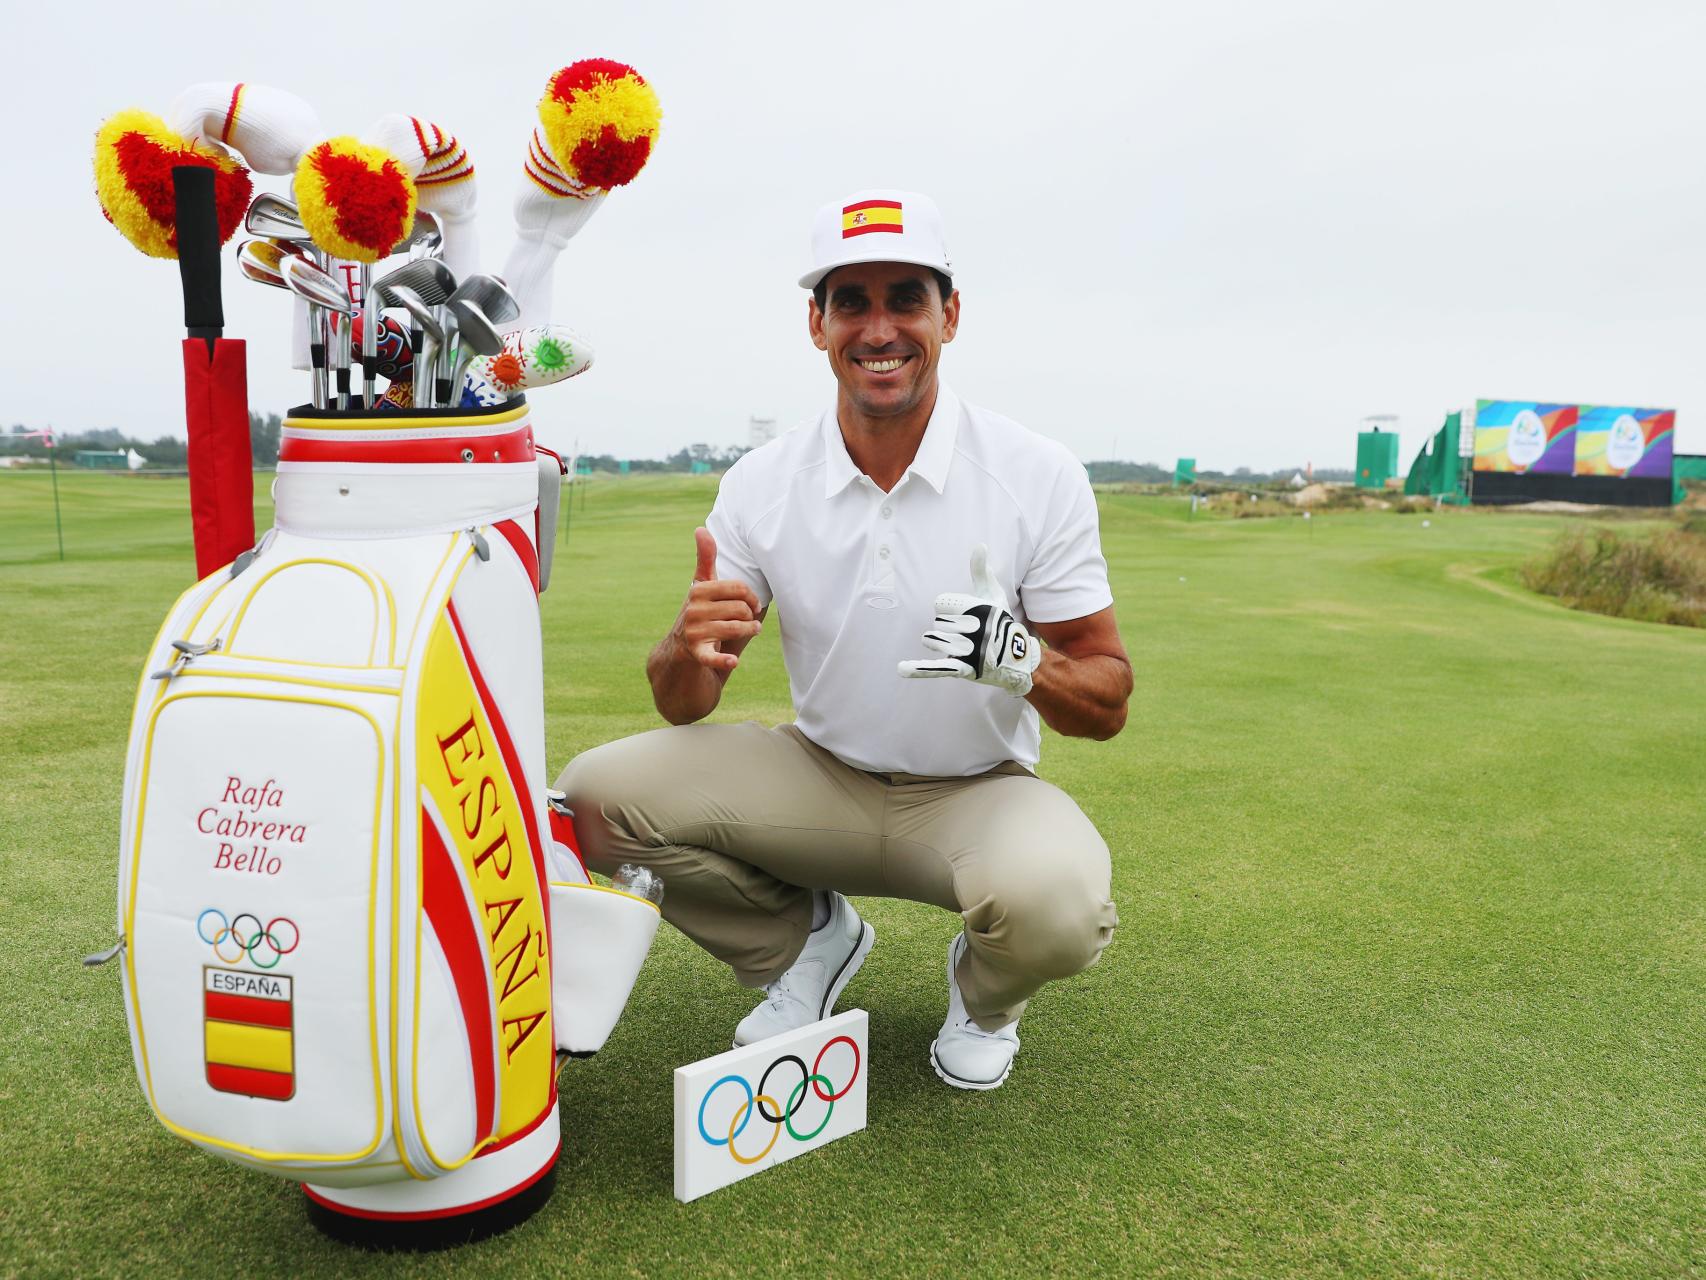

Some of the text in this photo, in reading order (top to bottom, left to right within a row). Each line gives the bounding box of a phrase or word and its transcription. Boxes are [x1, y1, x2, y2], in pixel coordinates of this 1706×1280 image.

[220, 775, 284, 813] Rafa
[197, 807, 307, 843] Cabrera
[213, 842, 283, 875] Bello
[436, 706, 548, 1066] ESPAÑA
[212, 972, 283, 997] ESPAÑA
